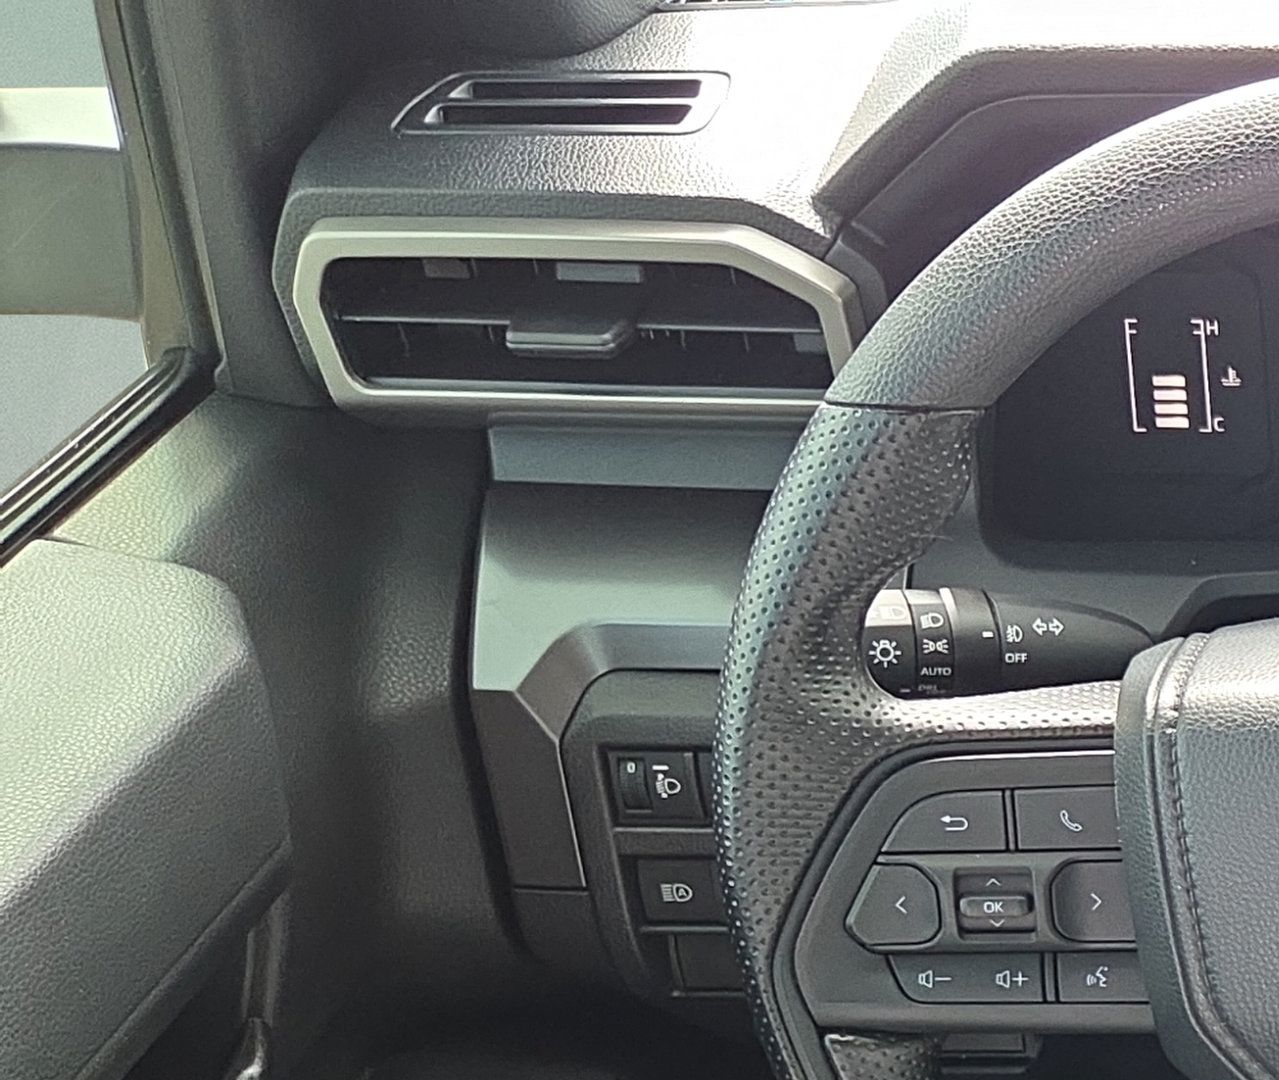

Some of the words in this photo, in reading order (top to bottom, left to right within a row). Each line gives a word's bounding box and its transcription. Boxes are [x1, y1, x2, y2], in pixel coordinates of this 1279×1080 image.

[1206, 320, 1218, 336] H
[1213, 417, 1224, 432] C
[1005, 652, 1027, 663] OFF
[921, 666, 951, 676] AUTO
[983, 901, 1004, 913] OK
